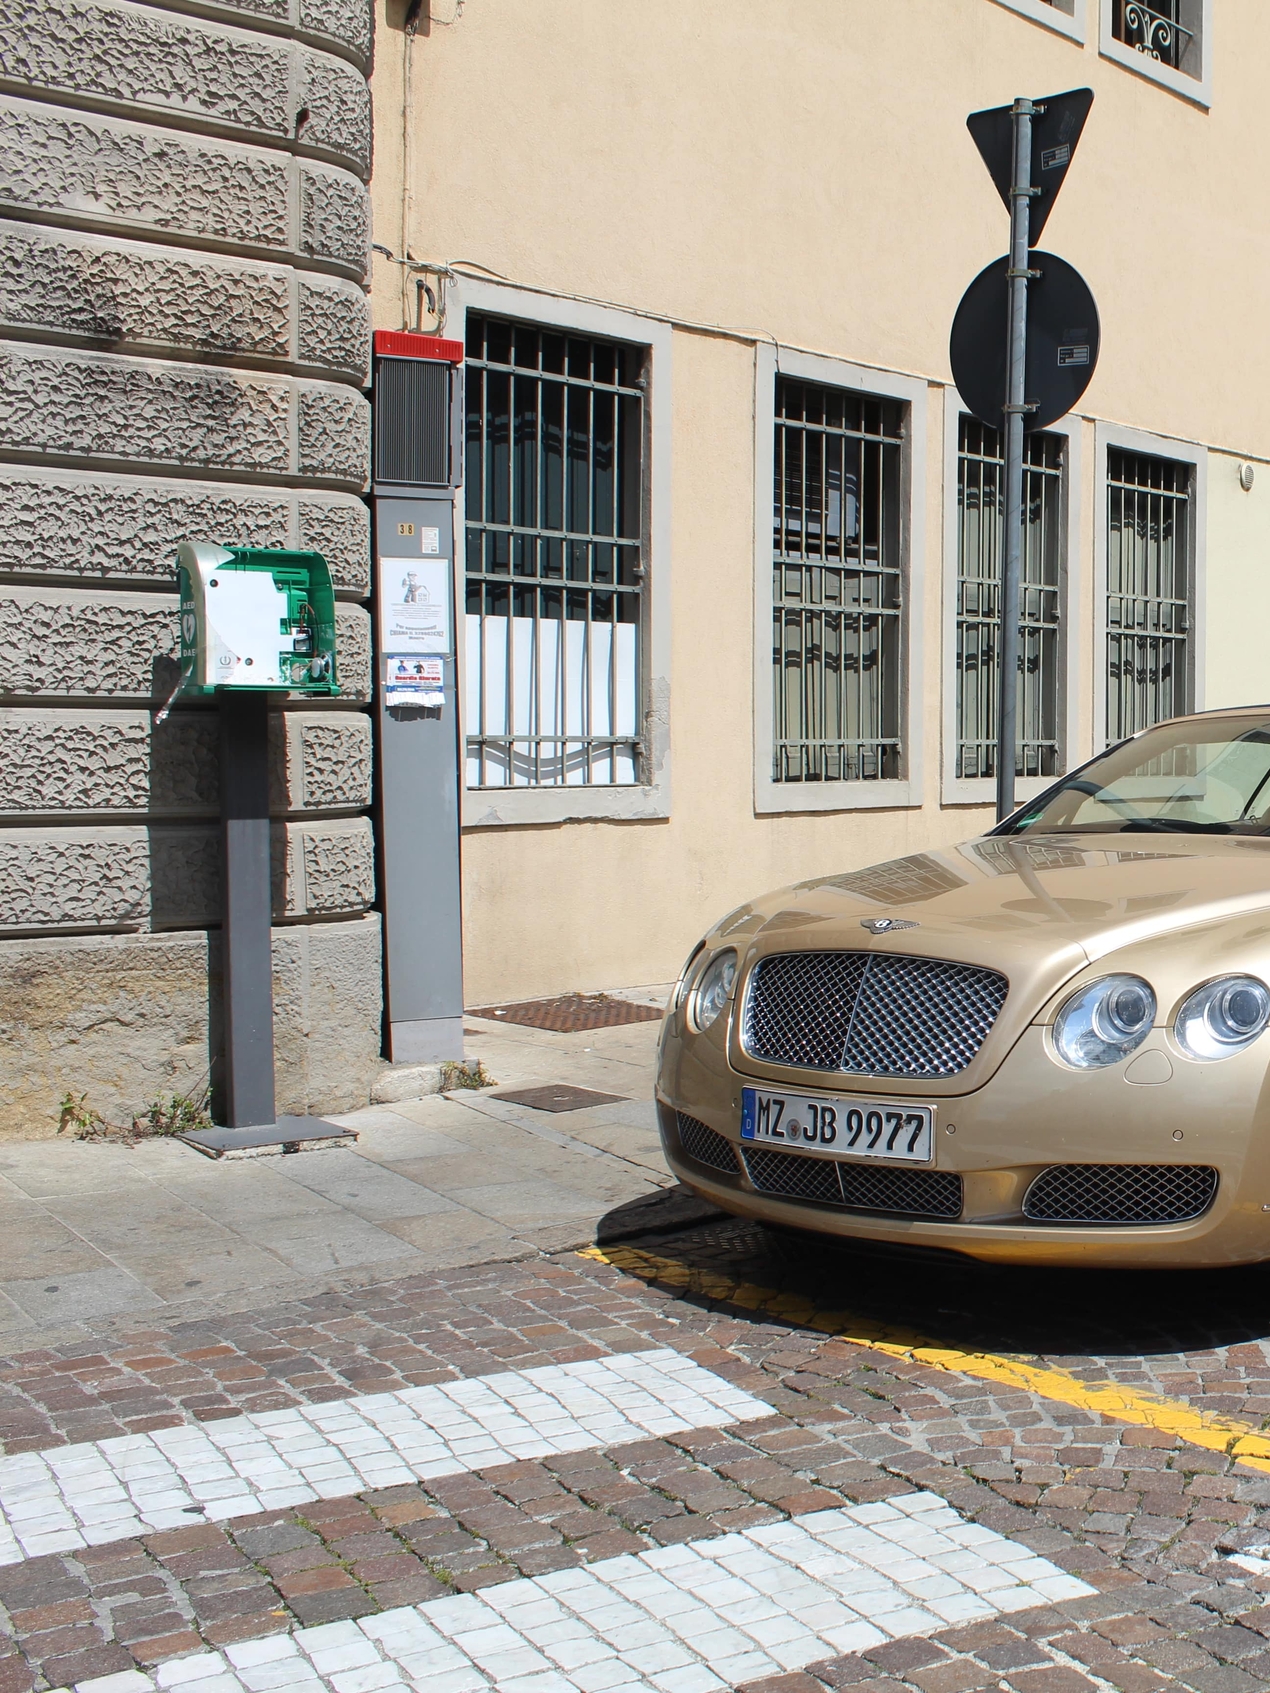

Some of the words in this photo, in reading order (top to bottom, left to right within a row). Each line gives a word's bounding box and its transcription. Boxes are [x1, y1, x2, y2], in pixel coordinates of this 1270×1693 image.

[399, 524, 413, 535] 38
[182, 602, 196, 610] AED
[183, 649, 196, 657] DAE
[757, 1096, 786, 1138] MZ
[803, 1103, 837, 1144] JB
[847, 1108, 925, 1153] 9977
